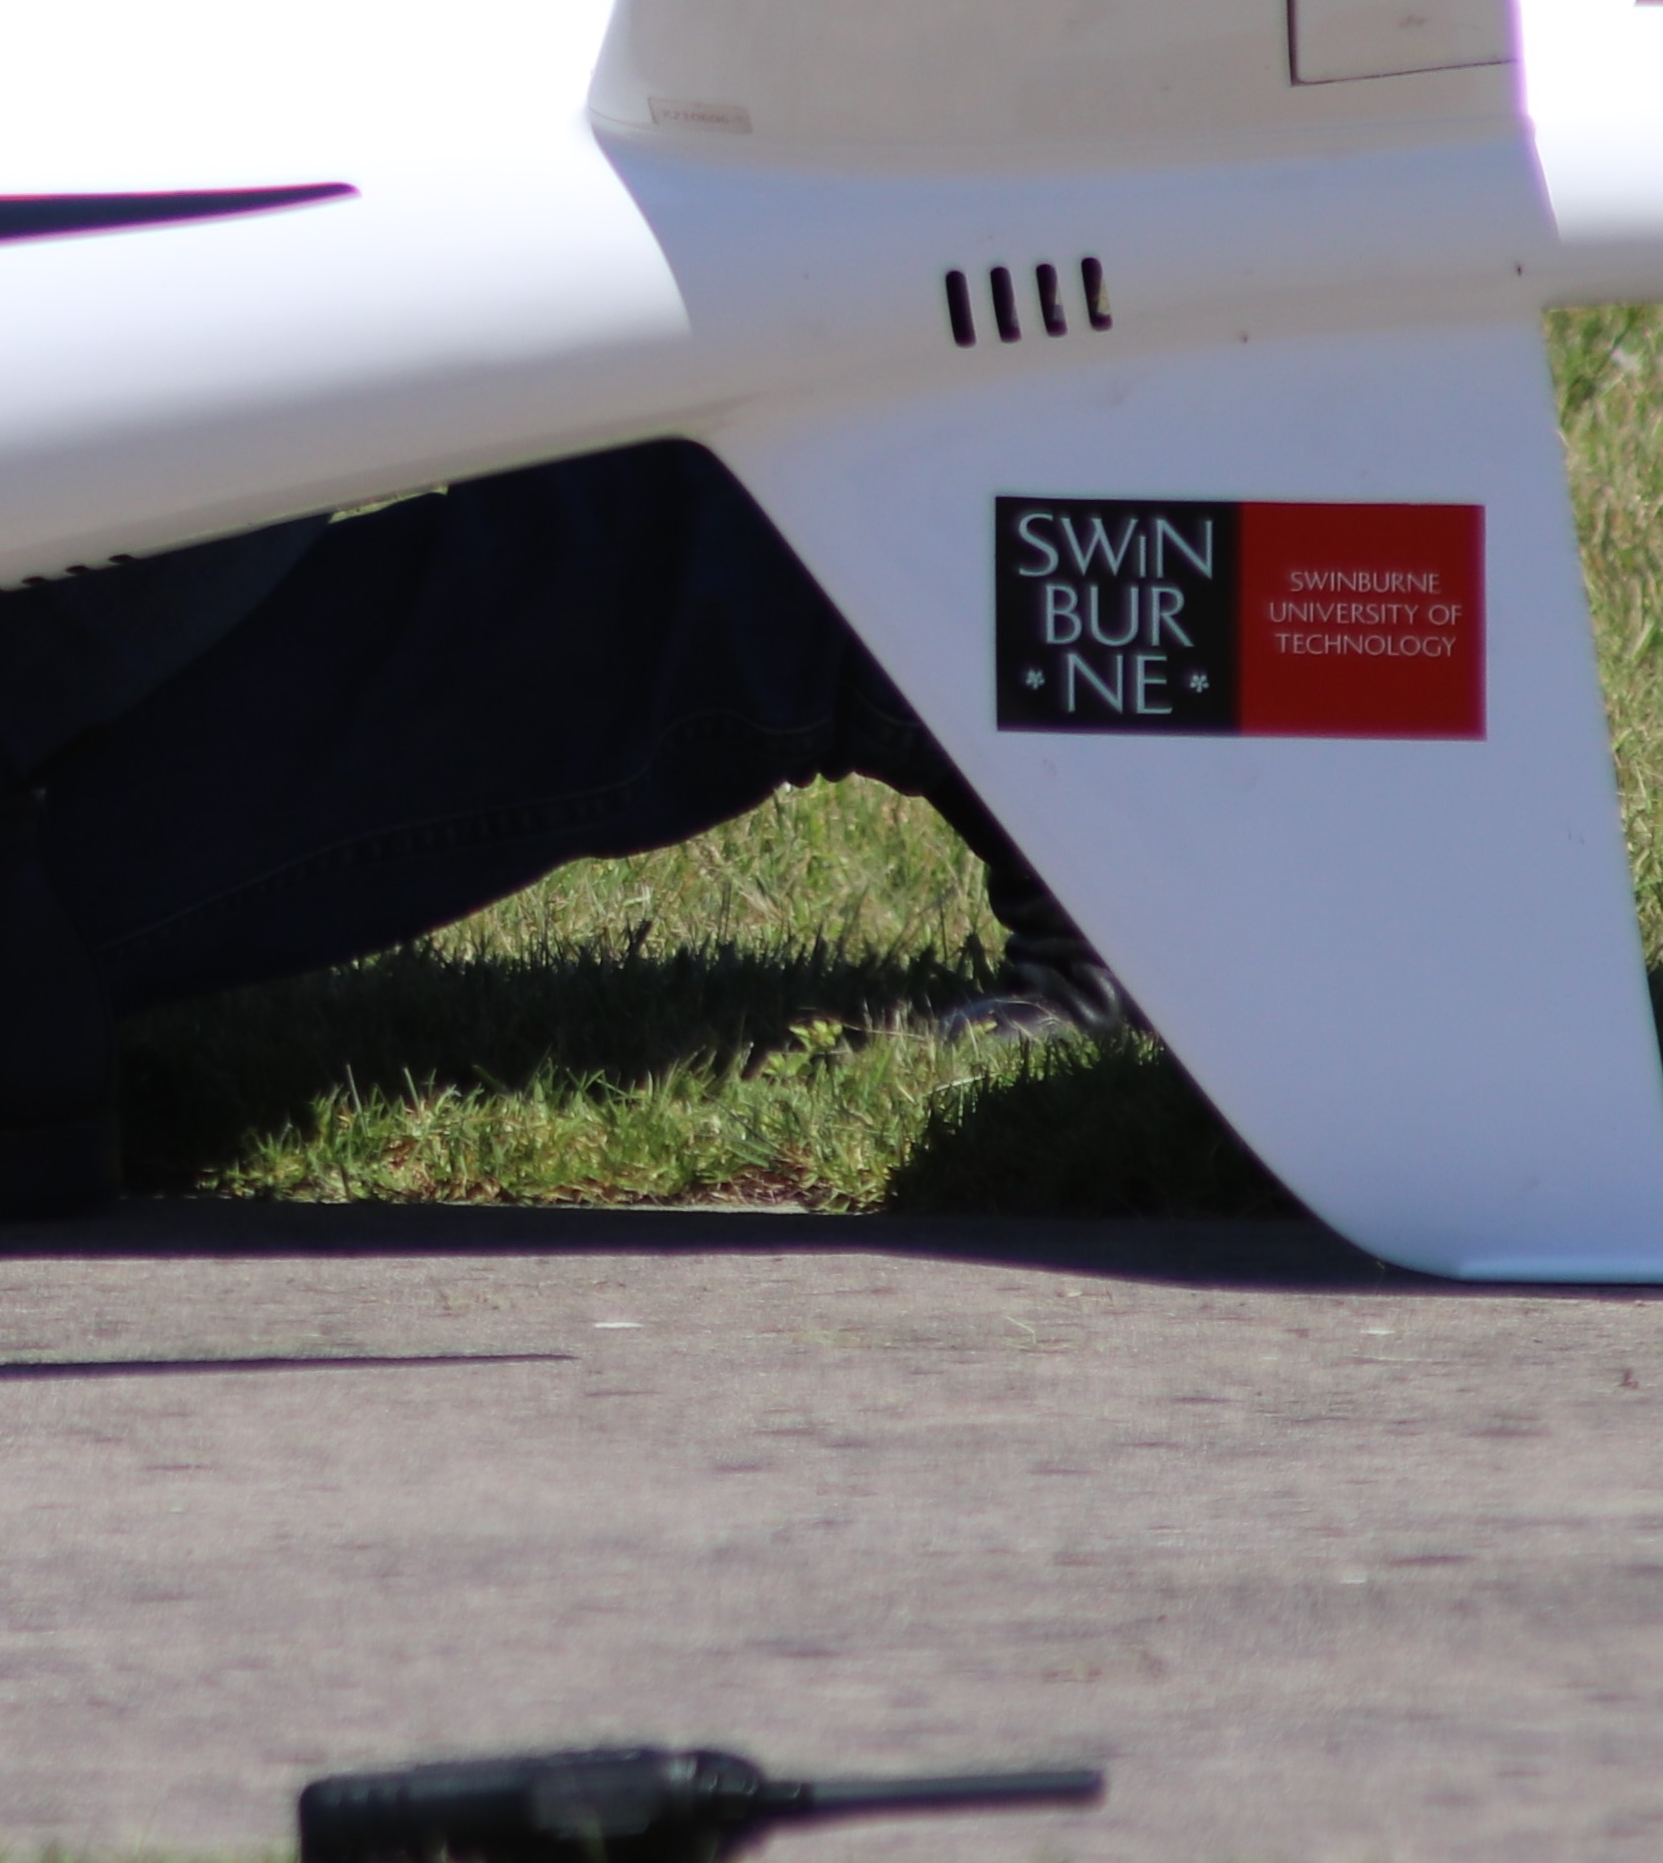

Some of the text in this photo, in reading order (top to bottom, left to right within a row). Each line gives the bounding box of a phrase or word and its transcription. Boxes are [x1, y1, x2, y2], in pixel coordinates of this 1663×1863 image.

[1017, 512, 1214, 580] SWIN
[1289, 570, 1442, 595] SWINBURNE
[1045, 583, 1195, 647] BUR
[1268, 601, 1463, 627] UNIVERSITY OF
[1274, 632, 1457, 658] TECHNOLOGY
[1065, 652, 1174, 715] NE
